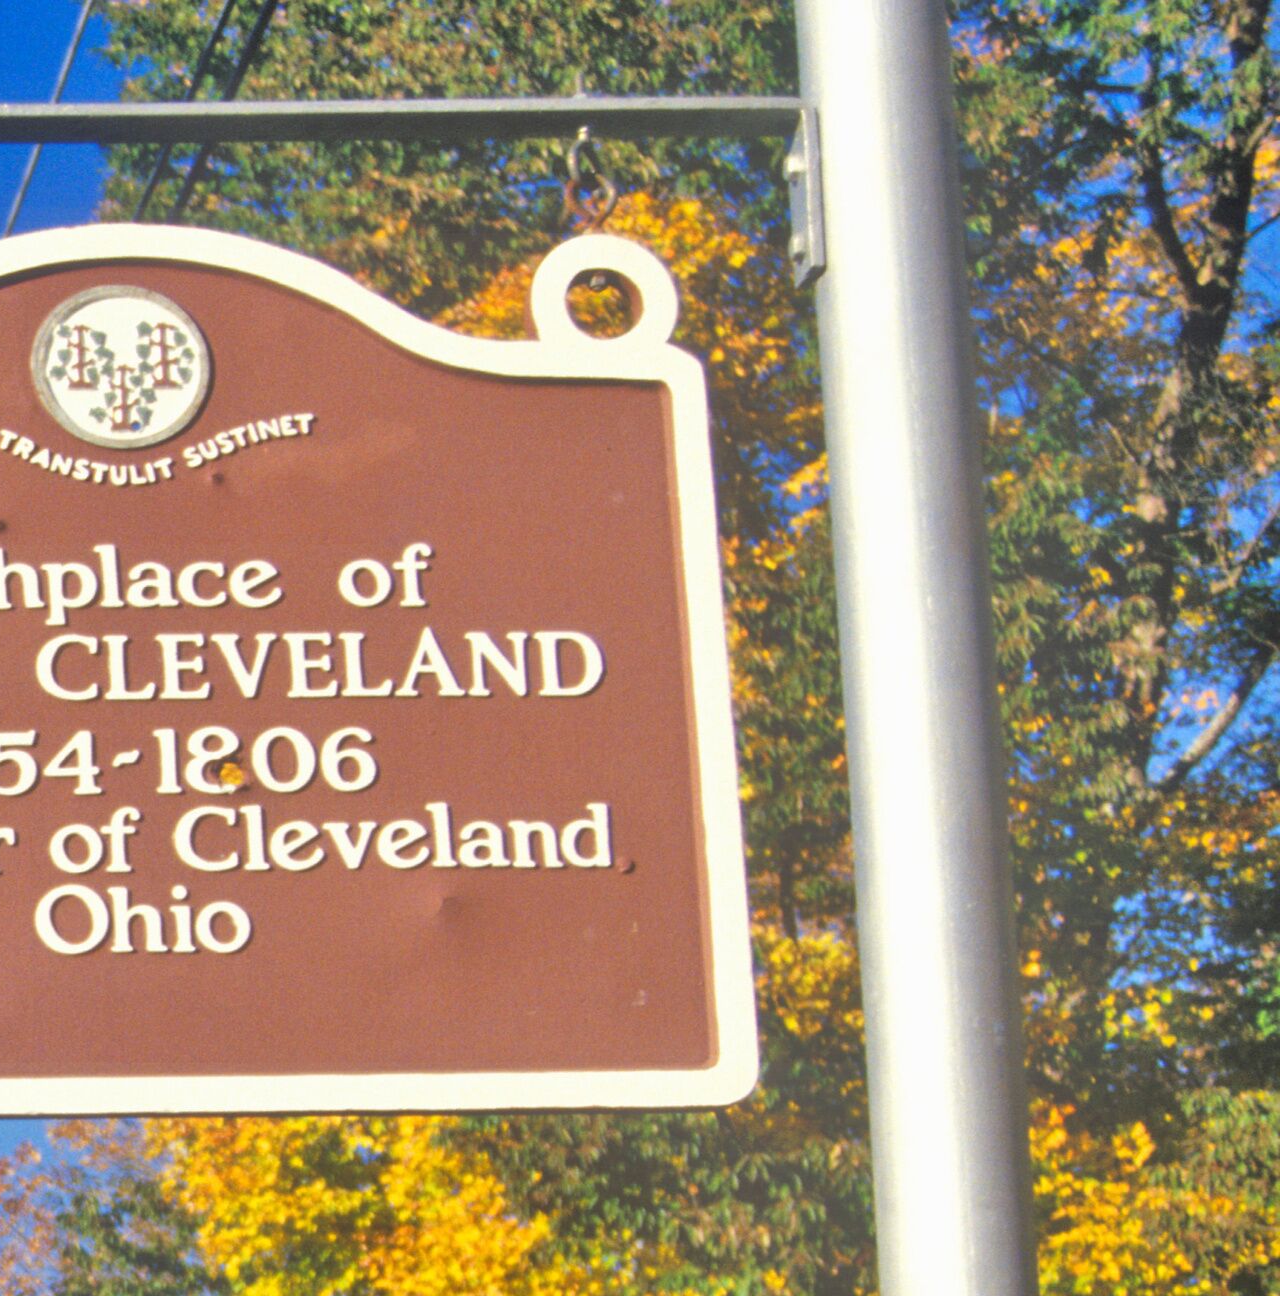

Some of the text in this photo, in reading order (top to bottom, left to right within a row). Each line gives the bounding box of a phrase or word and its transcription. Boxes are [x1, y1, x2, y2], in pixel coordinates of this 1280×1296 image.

[0, 429, 172, 486] TRANSTULIT
[183, 412, 314, 468] SUSTINET
[338, 542, 432, 607] of
[36, 626, 603, 701] CLEVELAND
[49, 806, 141, 874] of
[174, 801, 611, 872] Cleveland
[34, 884, 251, 955] Ohio
